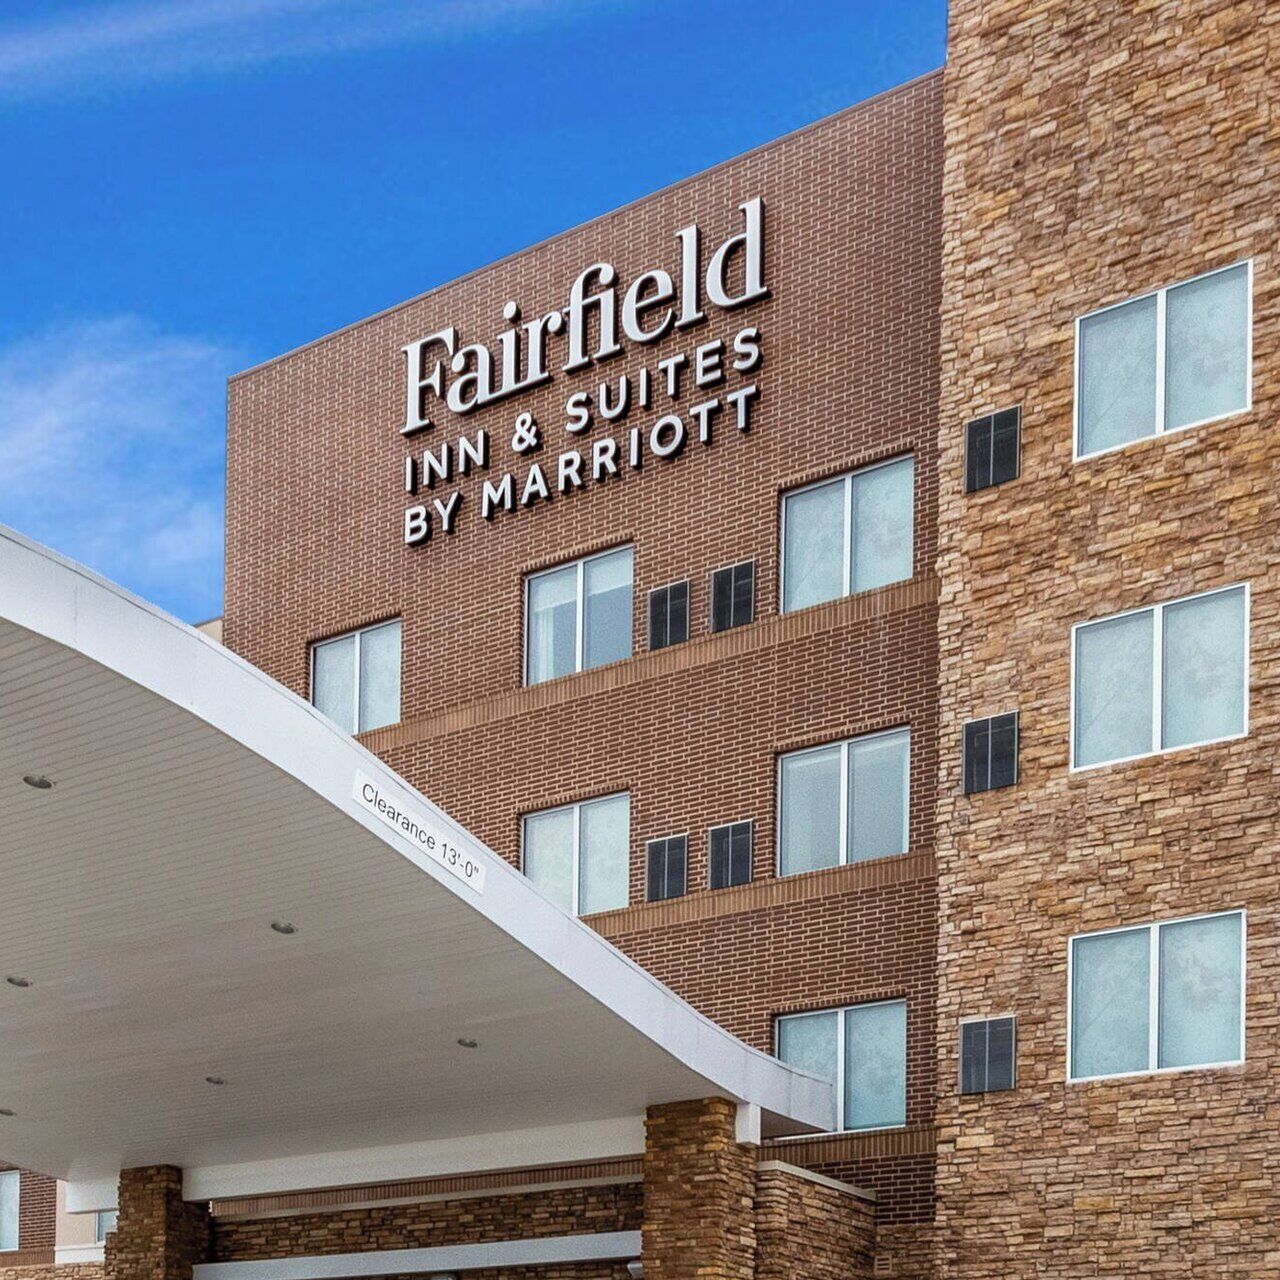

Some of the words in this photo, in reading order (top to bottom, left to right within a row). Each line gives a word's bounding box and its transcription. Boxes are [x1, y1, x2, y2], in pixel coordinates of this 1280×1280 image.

[400, 196, 768, 435] Fairfield
[404, 429, 487, 493] INN
[511, 412, 539, 453] &
[565, 327, 761, 434] SUITES
[404, 491, 460, 545] BY
[481, 385, 757, 518] MARRIOTT
[362, 783, 436, 850] Clearance
[441, 843, 479, 878] 13'-0"
